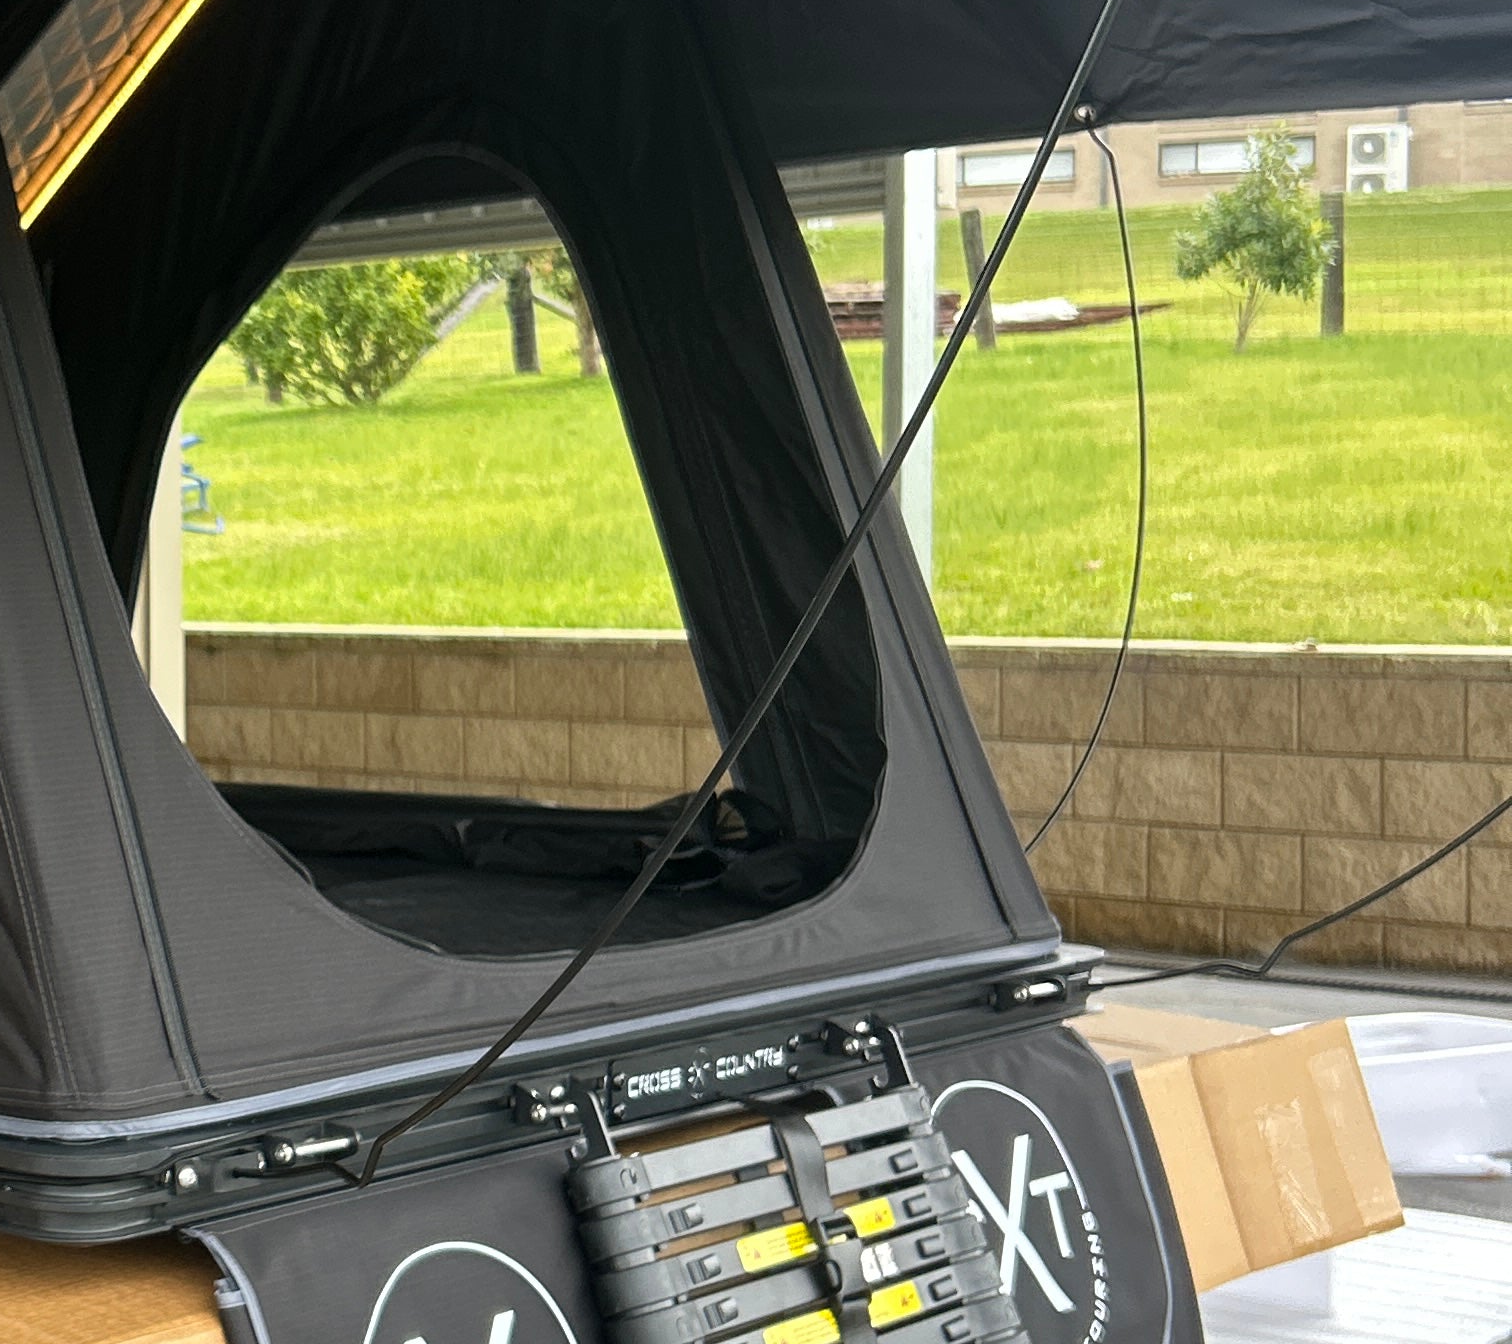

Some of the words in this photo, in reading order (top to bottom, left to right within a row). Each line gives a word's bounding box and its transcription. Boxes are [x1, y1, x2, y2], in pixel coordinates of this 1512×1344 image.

[627, 1066, 683, 1099] CROSS
[715, 1045, 786, 1080] COUNTRY
[951, 1133, 1075, 1312] XT
